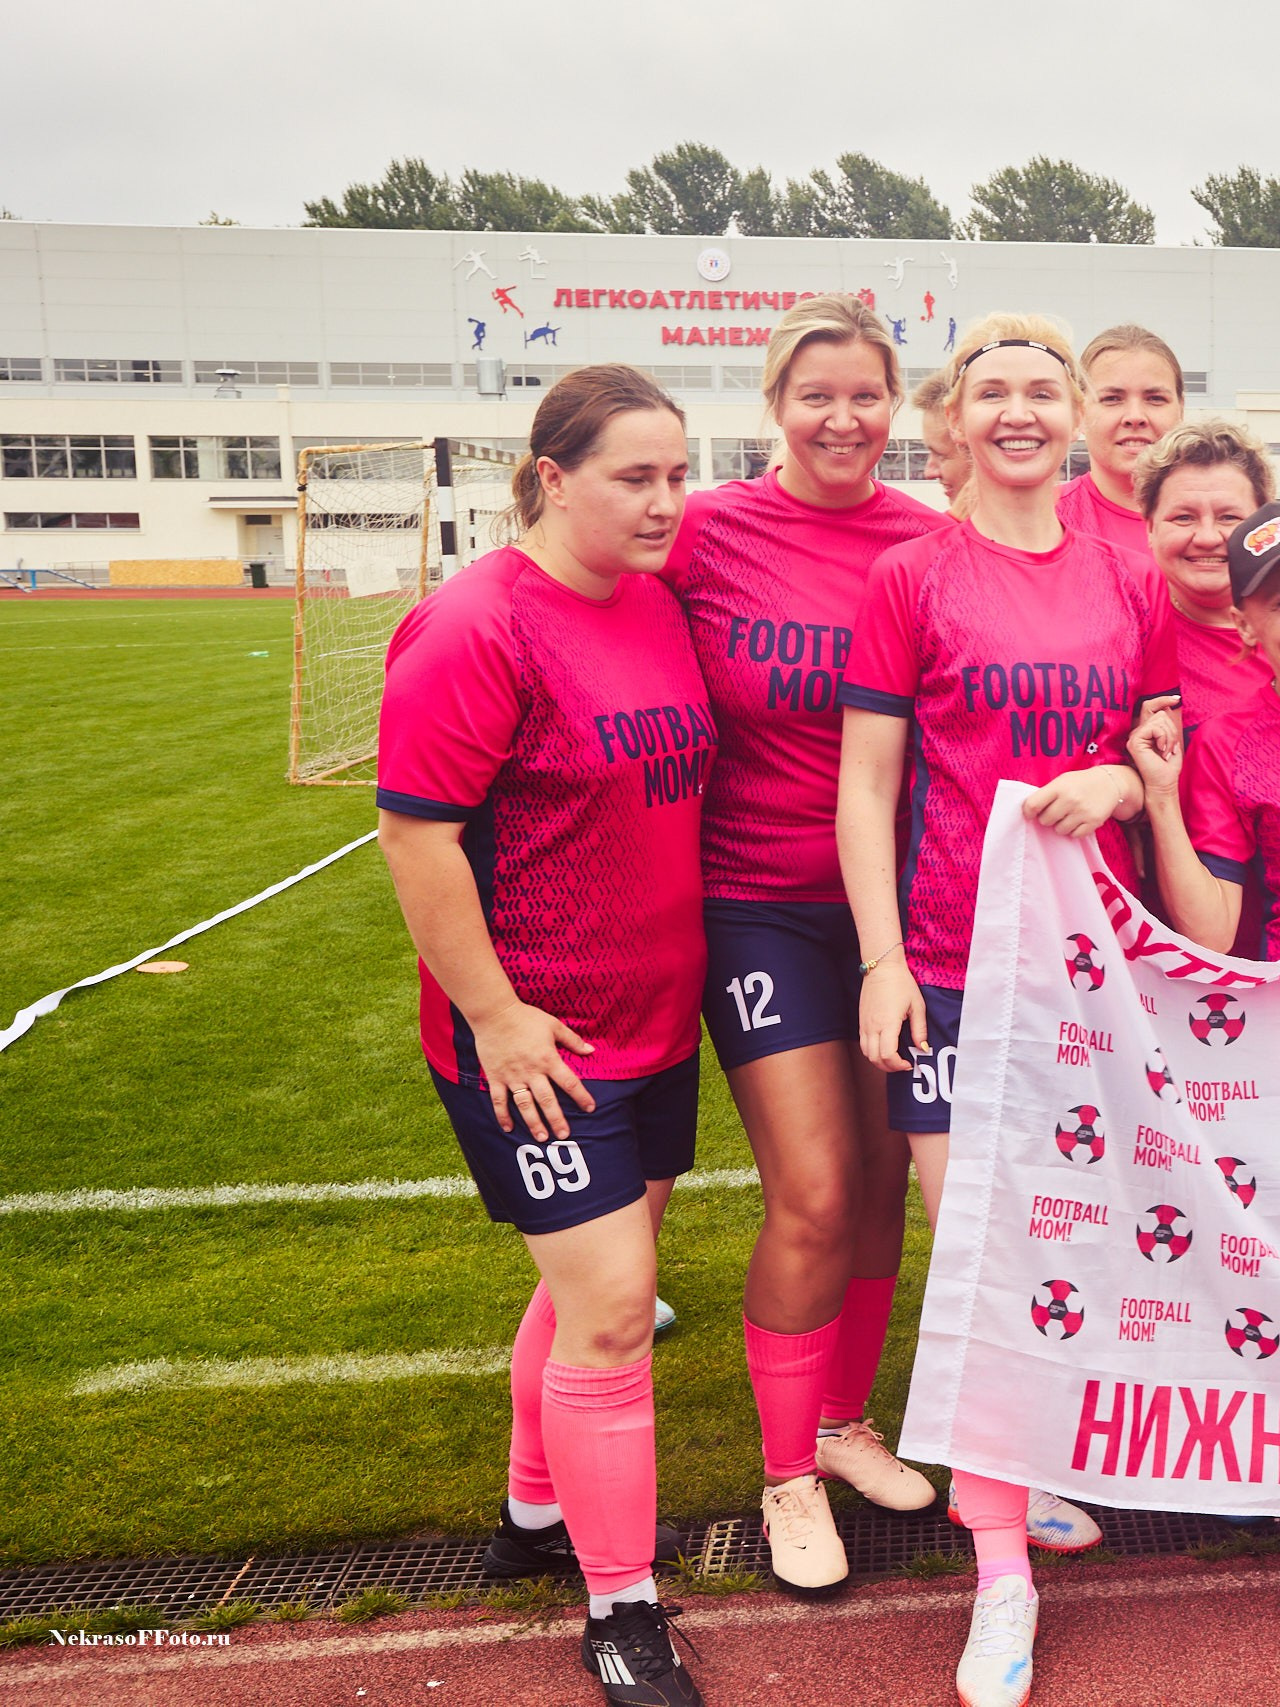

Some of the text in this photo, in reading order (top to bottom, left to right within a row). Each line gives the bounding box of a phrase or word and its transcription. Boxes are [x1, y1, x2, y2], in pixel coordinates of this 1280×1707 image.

[553, 288, 876, 311] ЛЕГКОАТЛЕТИЧЕЙ
[661, 326, 772, 347] МАНЕЖ
[726, 971, 782, 1032] 12
[1185, 1080, 1259, 1101] FOOTBALL
[1188, 1101, 1226, 1121] MOM!
[1136, 1125, 1201, 1165] FOOTBALL
[516, 1140, 591, 1200] 69
[1032, 1195, 1109, 1226] FOOTBALL
[1029, 1217, 1073, 1242] MOM!
[1120, 1298, 1192, 1323] FOOTBALL
[1118, 1320, 1156, 1343] MOM!
